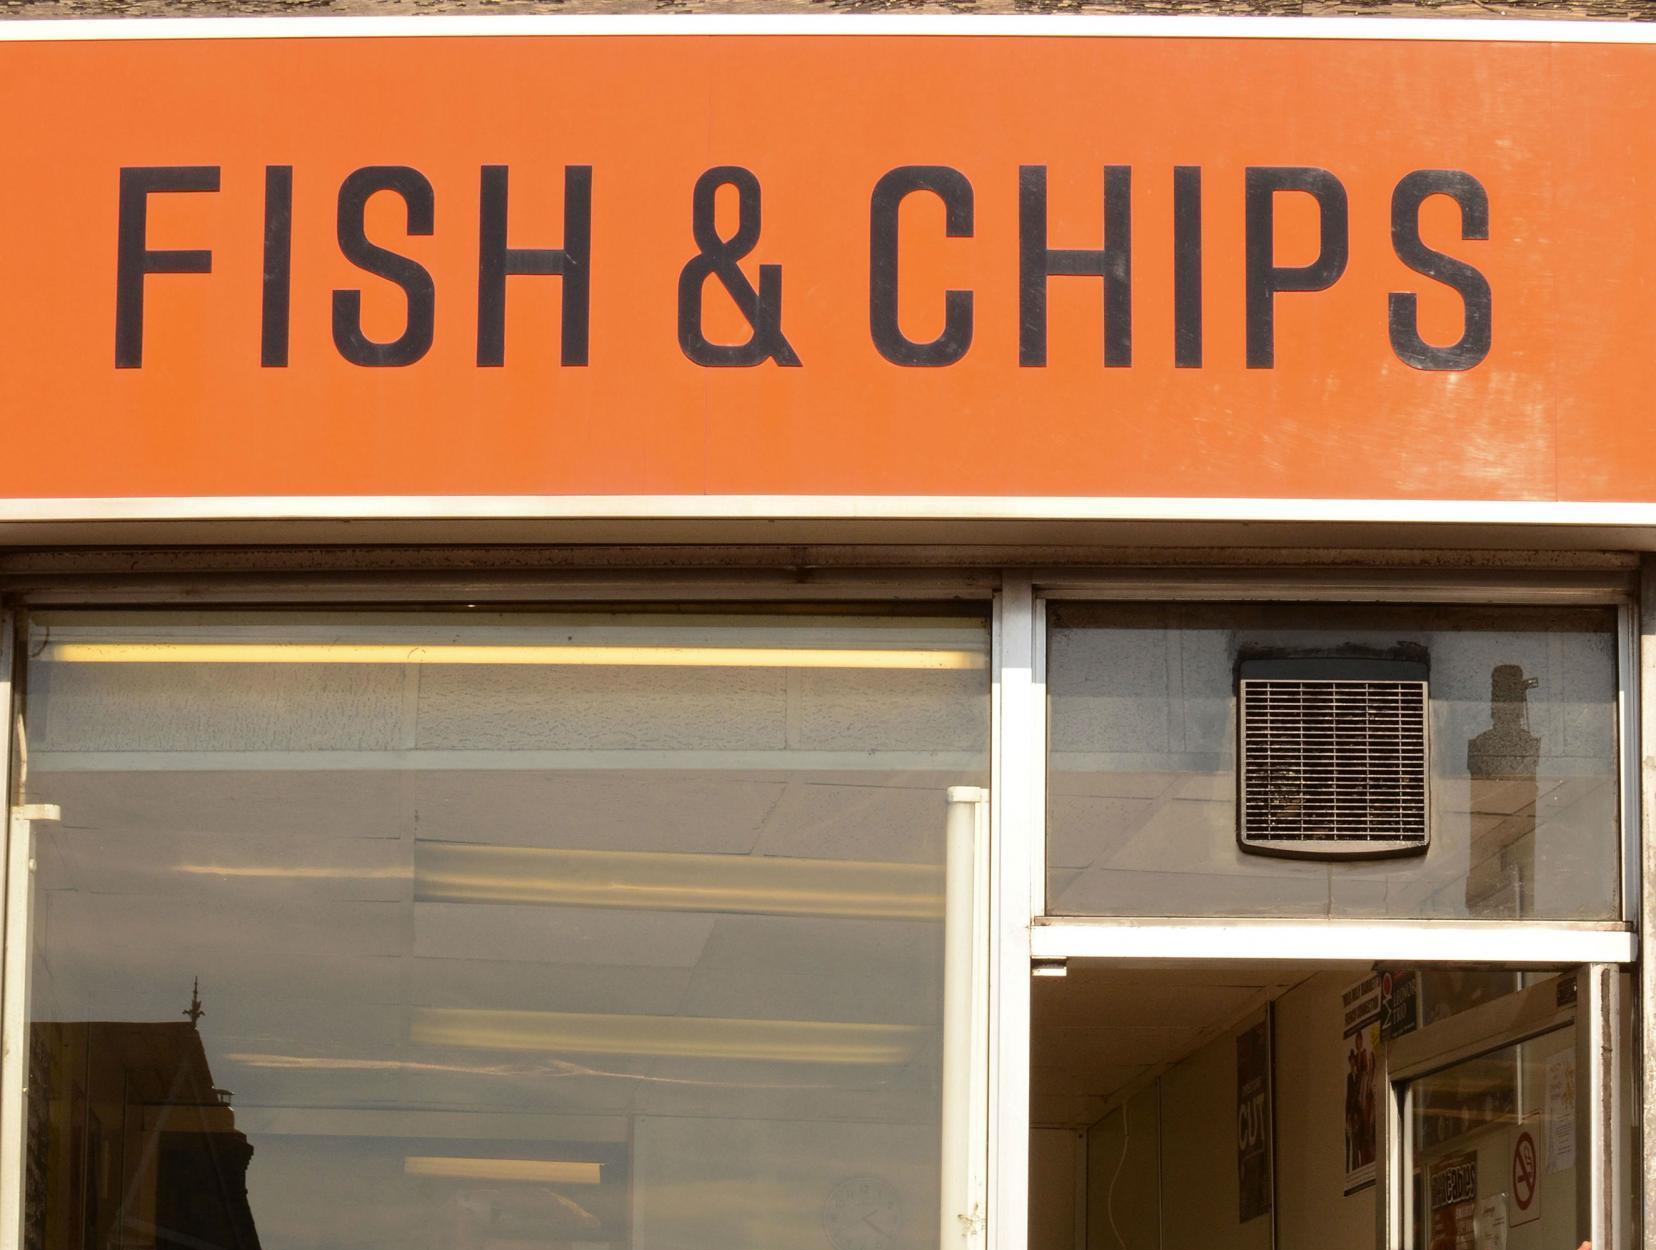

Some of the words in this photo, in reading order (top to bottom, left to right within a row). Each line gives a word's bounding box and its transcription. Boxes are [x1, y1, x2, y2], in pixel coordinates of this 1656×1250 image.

[115, 166, 592, 367] FISH
[678, 166, 801, 367] &
[870, 166, 1491, 371] CHIPS
